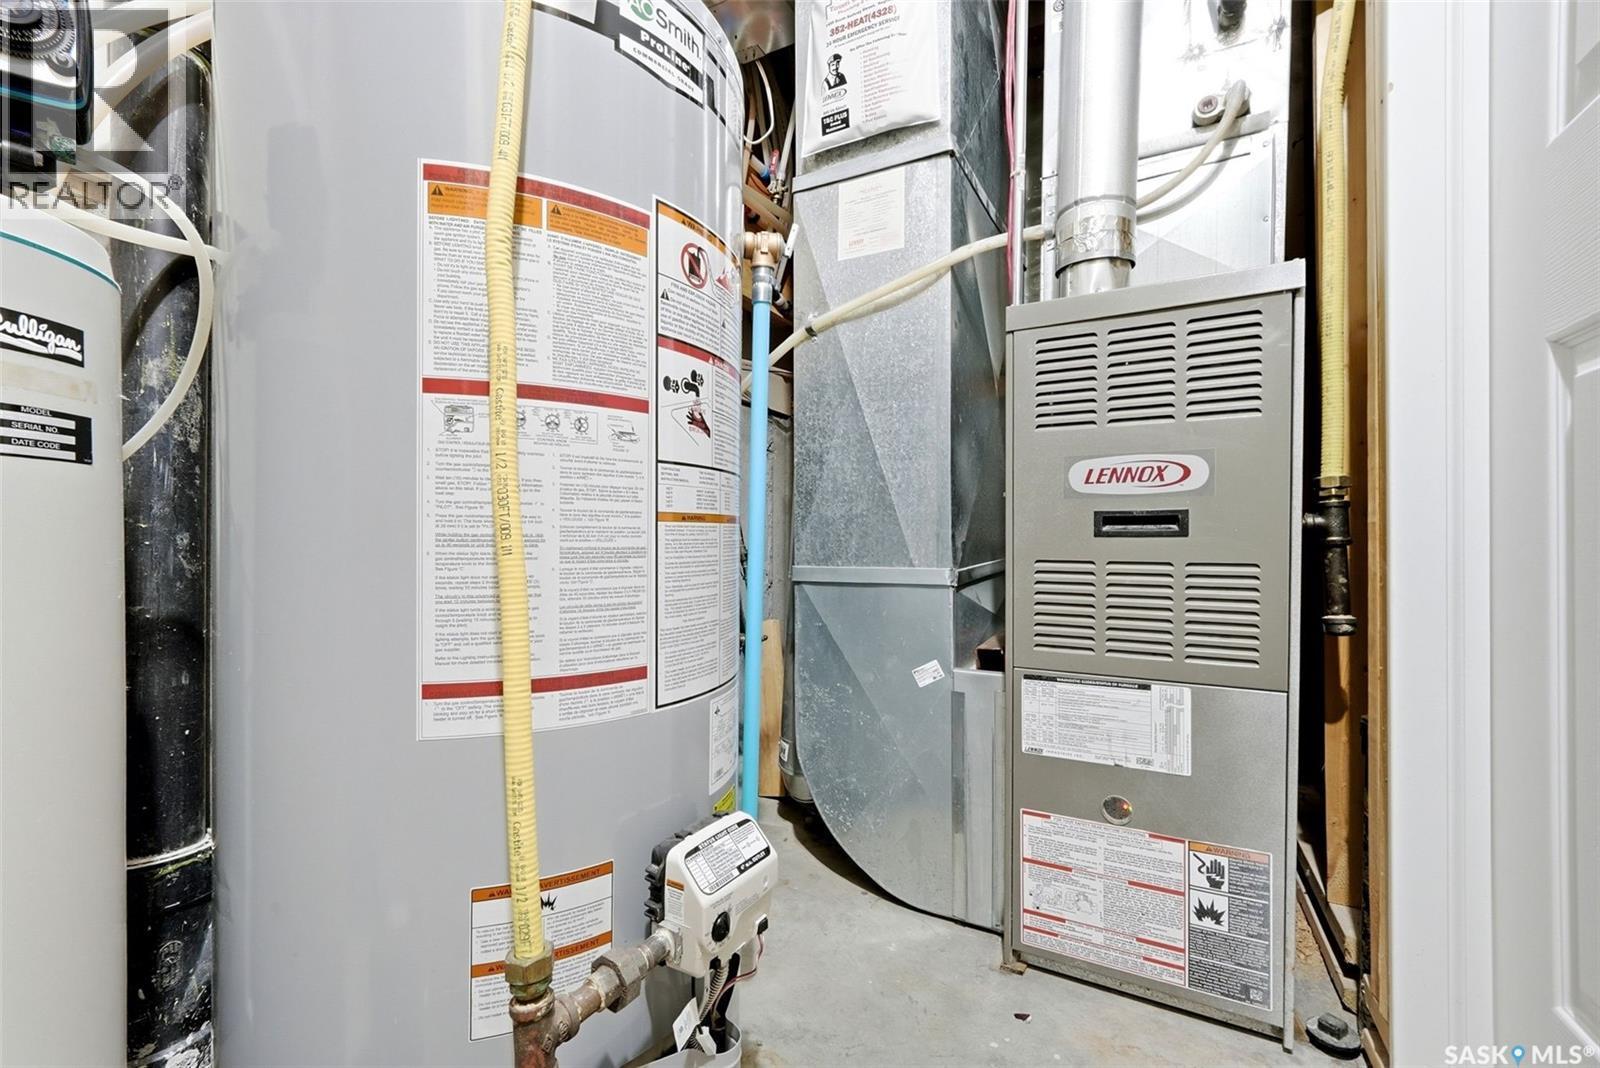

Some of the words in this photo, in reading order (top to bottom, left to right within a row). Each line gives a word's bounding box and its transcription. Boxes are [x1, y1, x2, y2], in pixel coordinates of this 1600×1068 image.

[656, 8, 699, 57] Smith
[848, 23, 877, 40] EMERGENCY
[640, 29, 691, 73] ProLine
[632, 47, 675, 79] COMMERCIAL
[676, 74, 695, 93] GRADE
[20, 405, 53, 417] MODEL
[11, 420, 43, 433] SERIAL
[45, 424, 60, 434] NO.
[11, 437, 36, 449] DATE
[37, 439, 61, 451] CODE
[495, 452, 507, 469] 1/2
[1084, 465, 1169, 485] LENNOX
[515, 886, 528, 903] 1/2
